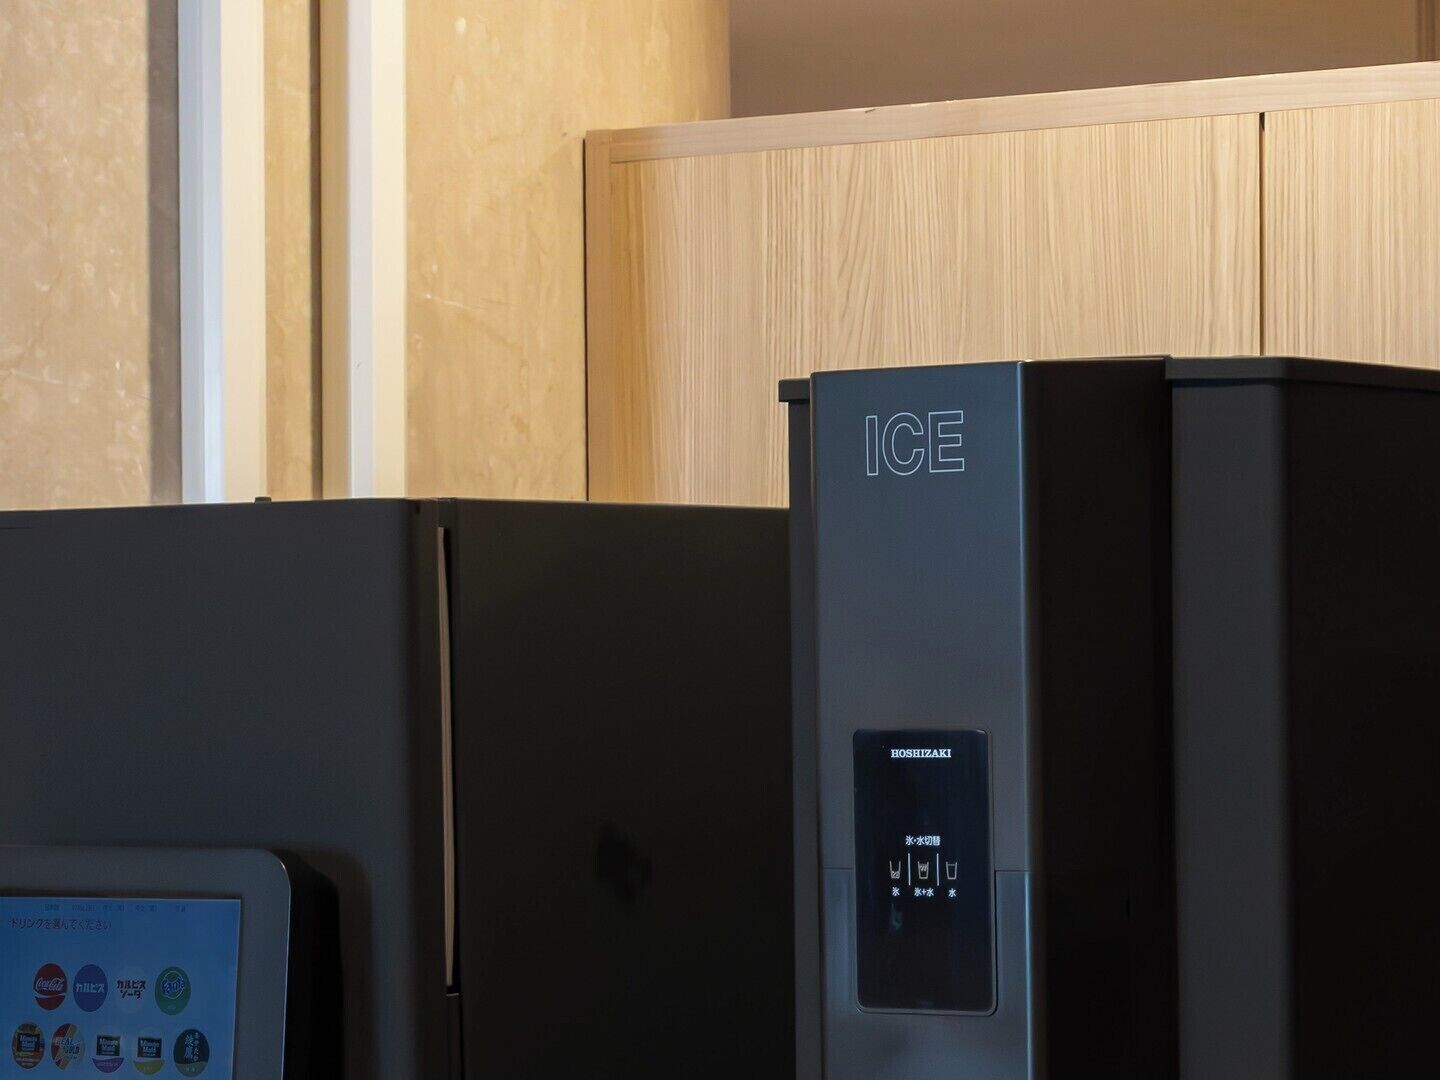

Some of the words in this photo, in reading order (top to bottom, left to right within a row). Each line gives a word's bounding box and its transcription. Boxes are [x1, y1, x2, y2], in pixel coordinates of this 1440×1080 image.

[866, 410, 965, 476] ICE
[891, 749, 951, 758] HOSHIZAKI
[892, 887, 900, 897] 氷
[948, 888, 957, 898] 水
[75, 982, 105, 994] カルピス
[116, 979, 147, 990] カルピス
[120, 989, 142, 999] ソーダ
